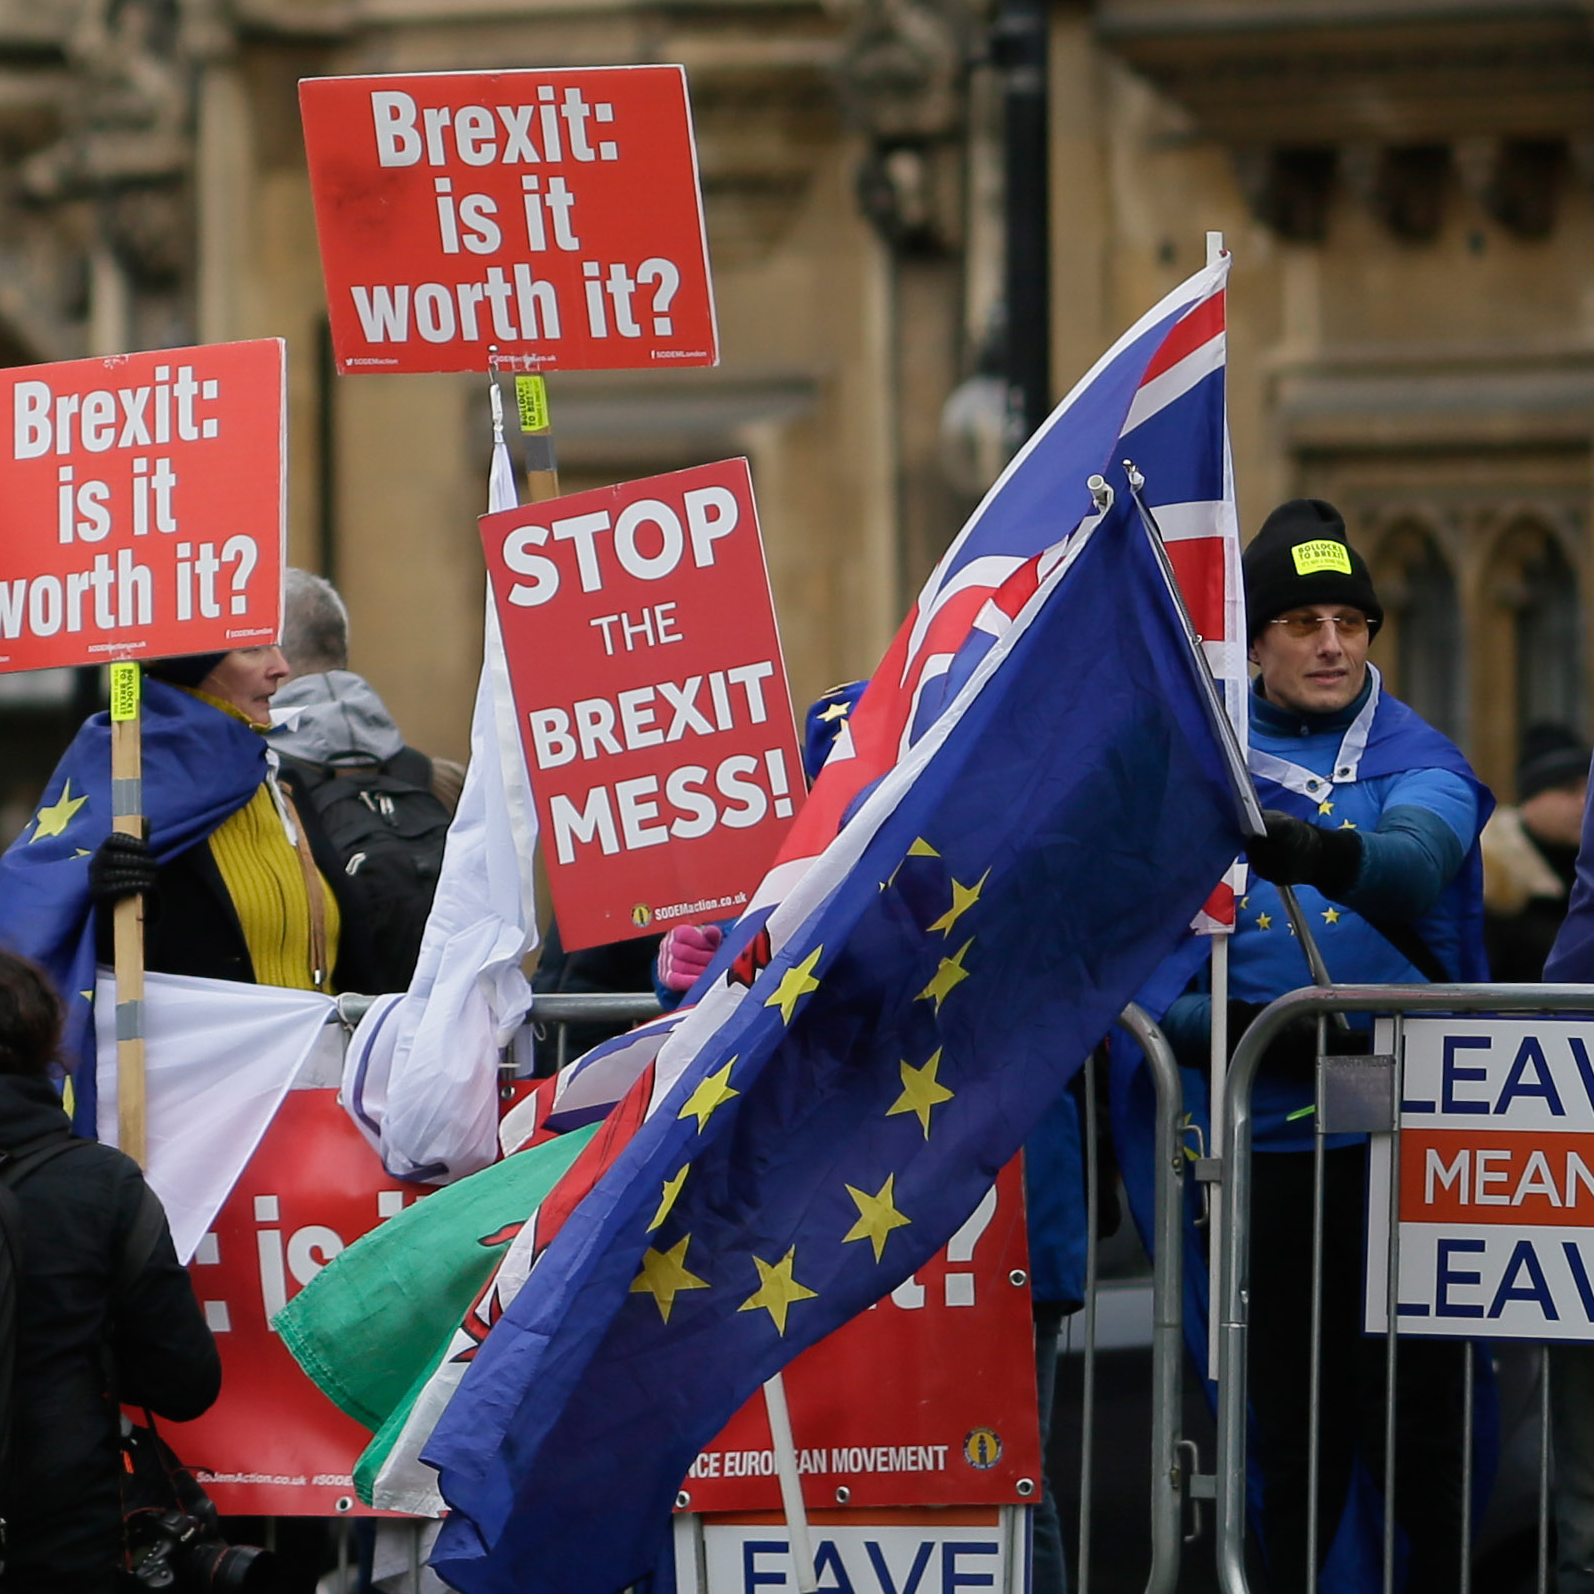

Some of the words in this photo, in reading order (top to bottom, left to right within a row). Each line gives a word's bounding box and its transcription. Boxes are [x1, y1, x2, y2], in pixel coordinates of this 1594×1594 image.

[370, 85, 619, 168] Brexit:
[435, 177, 502, 254] is
[521, 174, 581, 252] it
[351, 263, 562, 345] worth
[582, 257, 681, 339] it?
[14, 365, 219, 460] Brexit:
[58, 465, 112, 544] is
[132, 457, 177, 536] it
[175, 534, 258, 622] it?
[502, 486, 739, 607] STOP
[589, 602, 683, 656] THE
[529, 660, 774, 769] BREXIT
[549, 748, 795, 866] MESS!
[654, 892, 748, 921] SODEMaction.co.uk
[831, 1444, 950, 1475] MOVEMENT
